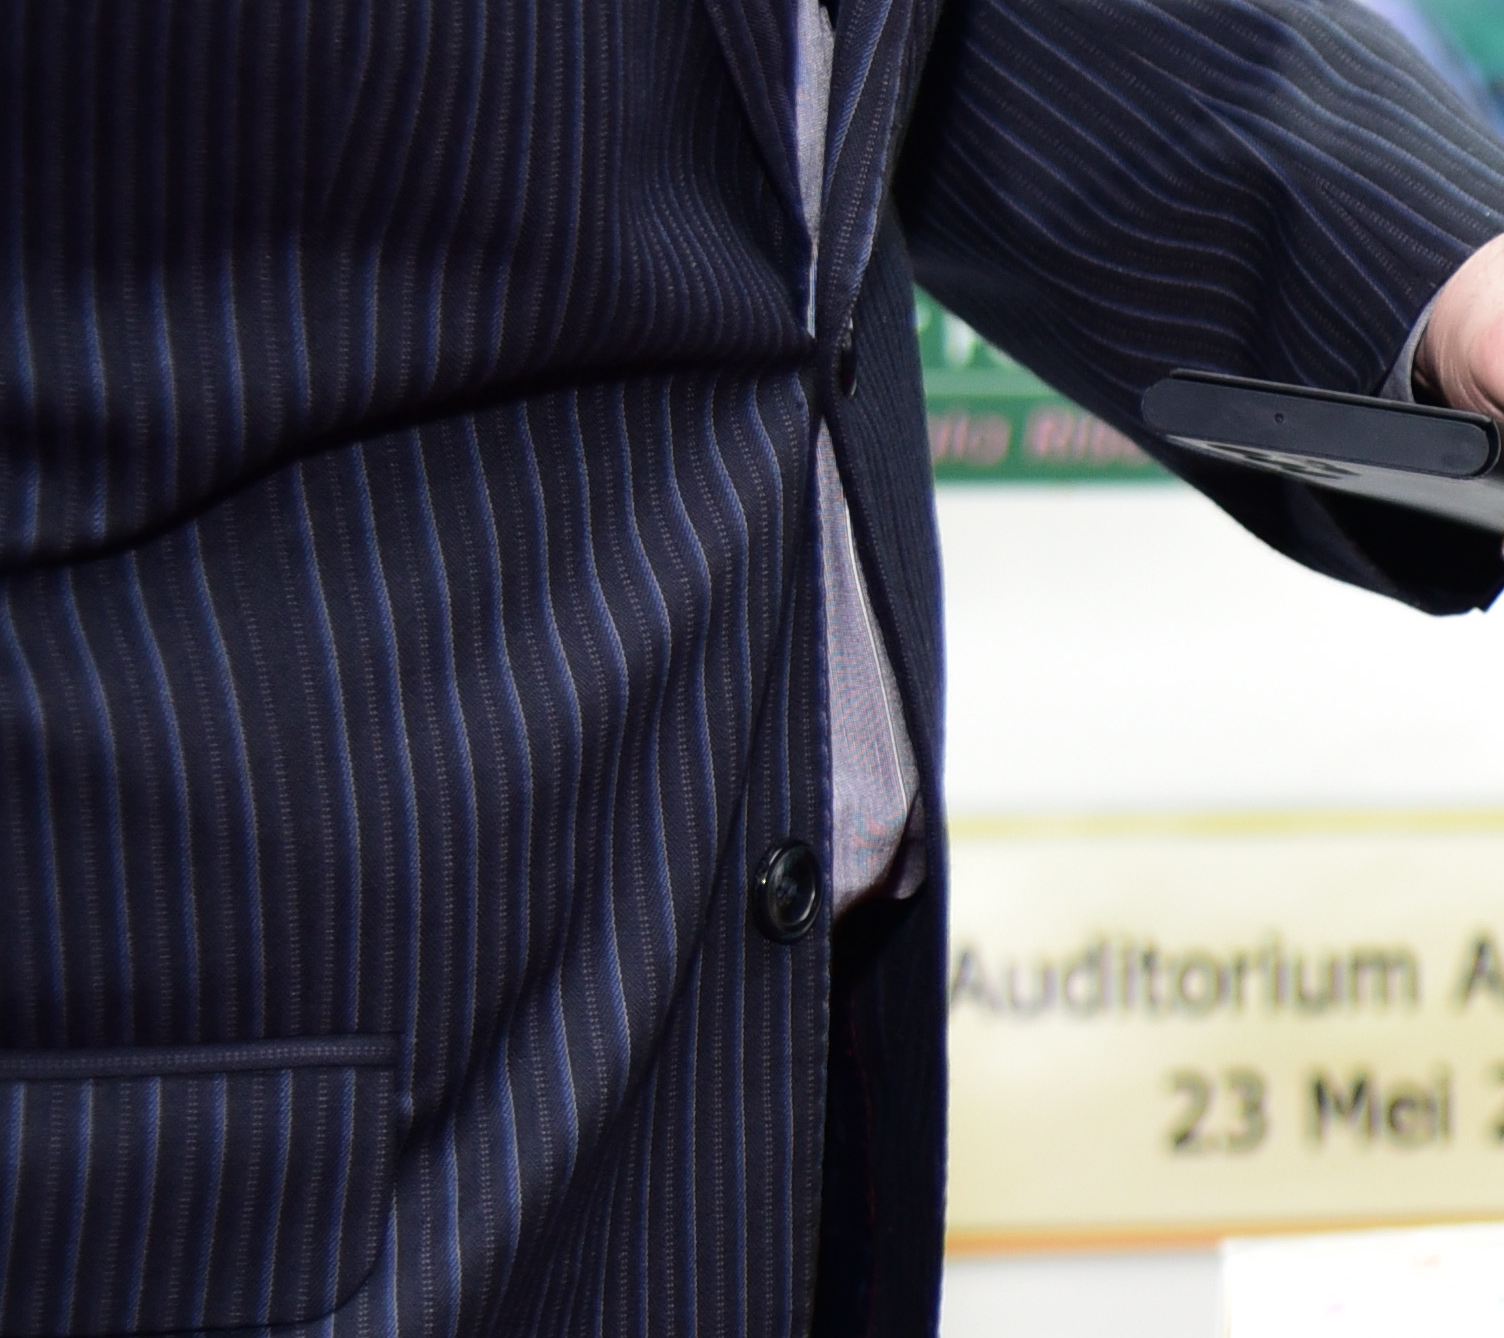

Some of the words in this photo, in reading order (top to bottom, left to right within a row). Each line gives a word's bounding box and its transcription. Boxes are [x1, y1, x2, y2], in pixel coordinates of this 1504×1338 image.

[949, 933, 1420, 1015] Auditorium
[1170, 1066, 1268, 1153] 23
[1306, 1064, 1452, 1144] Mei
